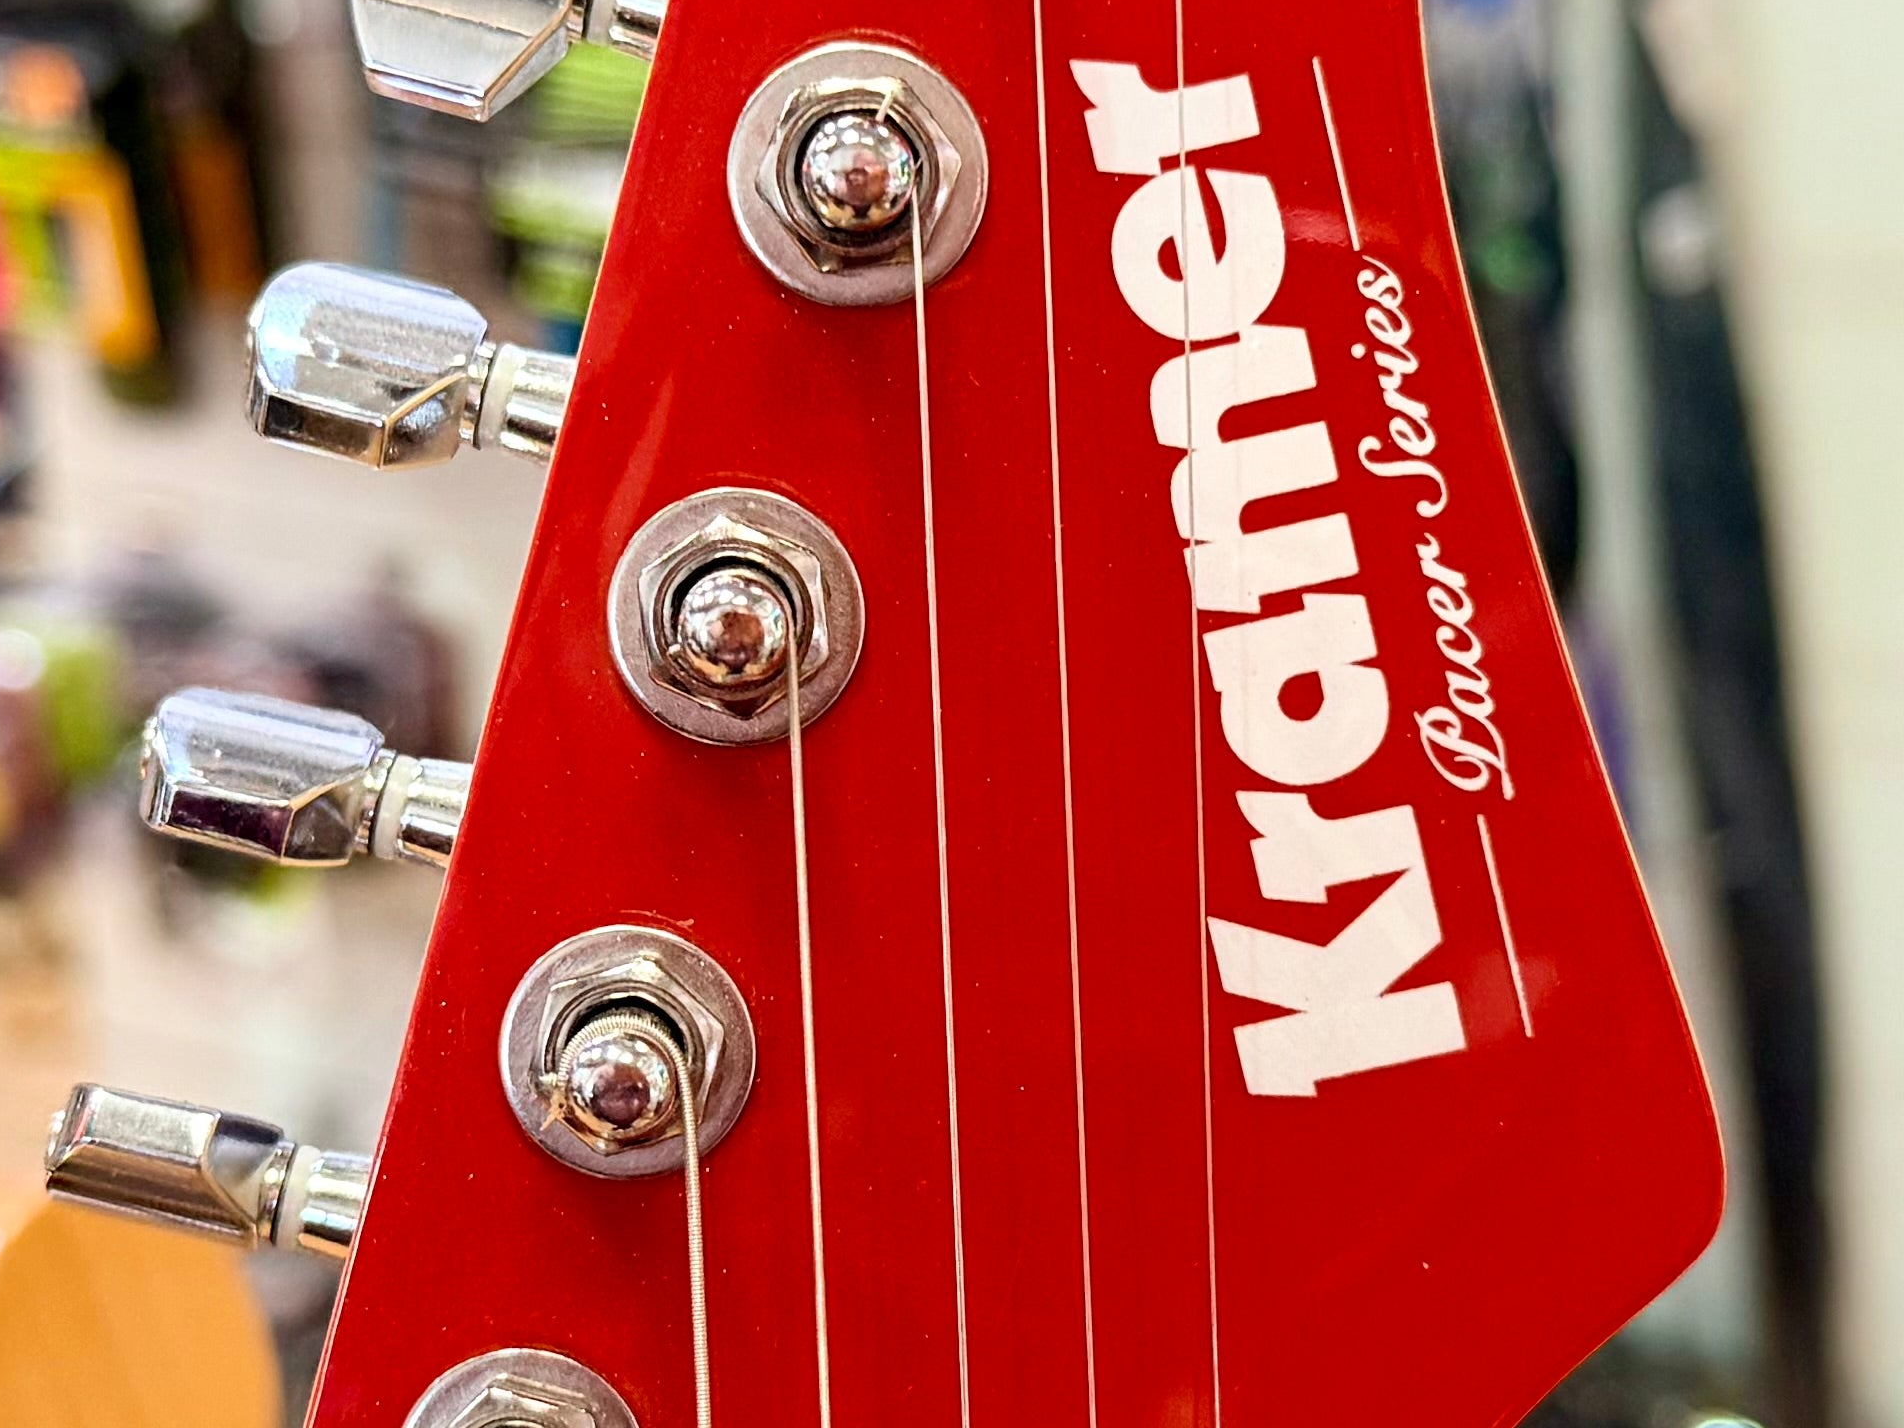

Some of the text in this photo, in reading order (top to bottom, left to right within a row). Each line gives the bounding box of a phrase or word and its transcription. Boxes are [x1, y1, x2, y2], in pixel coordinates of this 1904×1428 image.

[1070, 59, 1467, 1097] Kramer
[1350, 255, 1514, 800] Pacer Series
